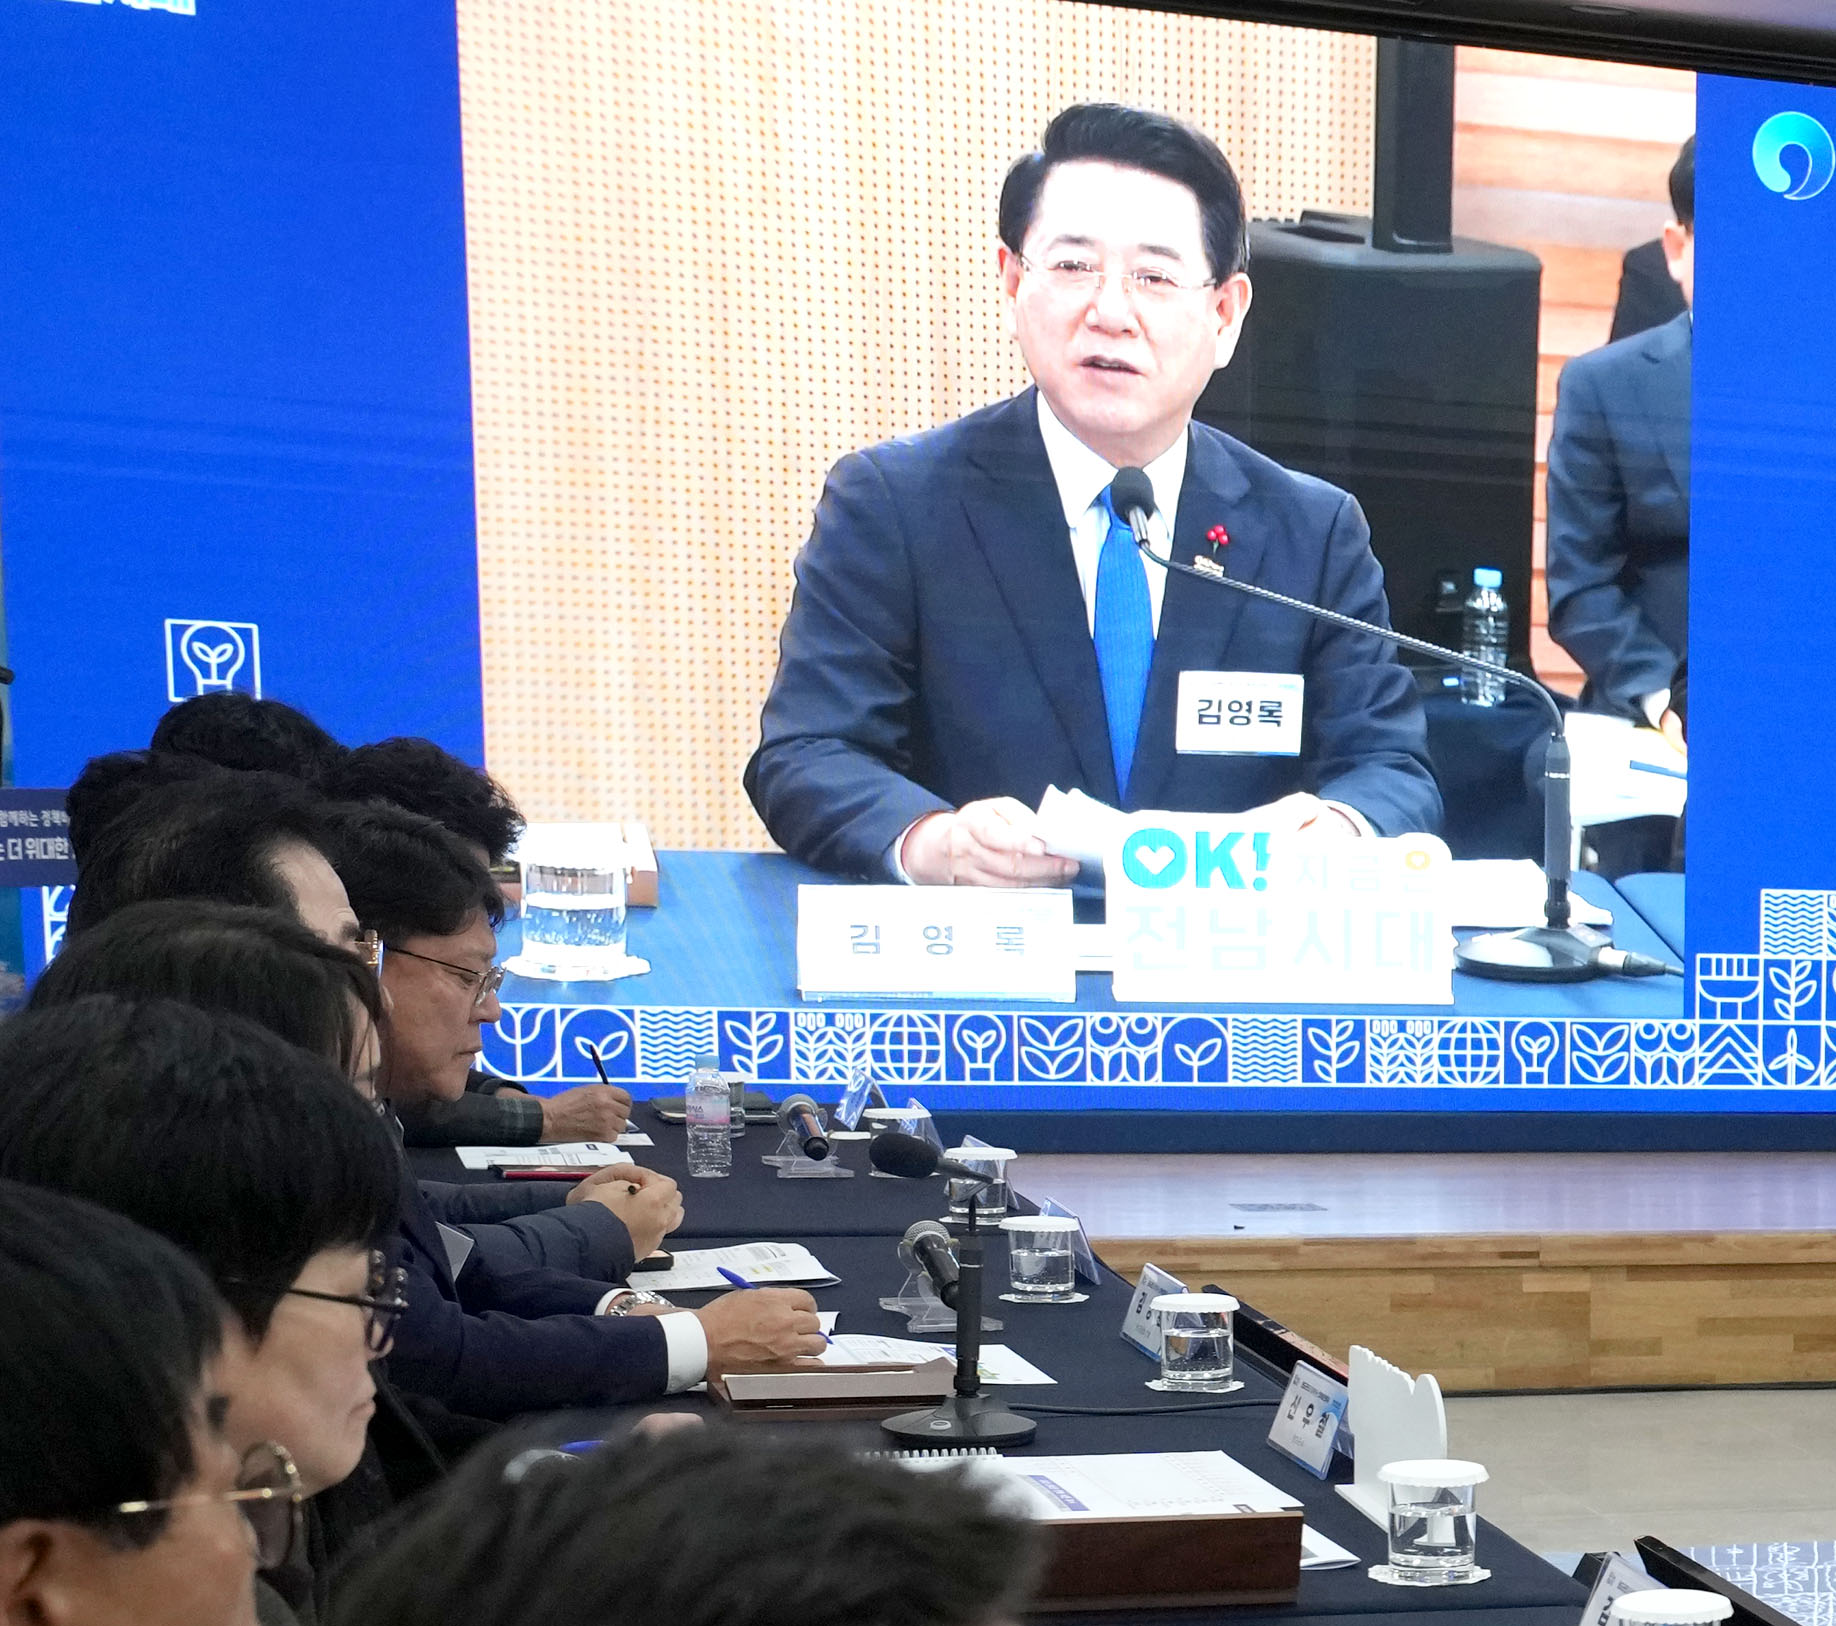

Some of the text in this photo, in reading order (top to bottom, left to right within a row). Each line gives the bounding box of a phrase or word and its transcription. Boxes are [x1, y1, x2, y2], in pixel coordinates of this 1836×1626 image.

[1197, 699, 1283, 727] 김영록
[25, 836, 69, 860] 위대한
[1122, 828, 1272, 892] OK!
